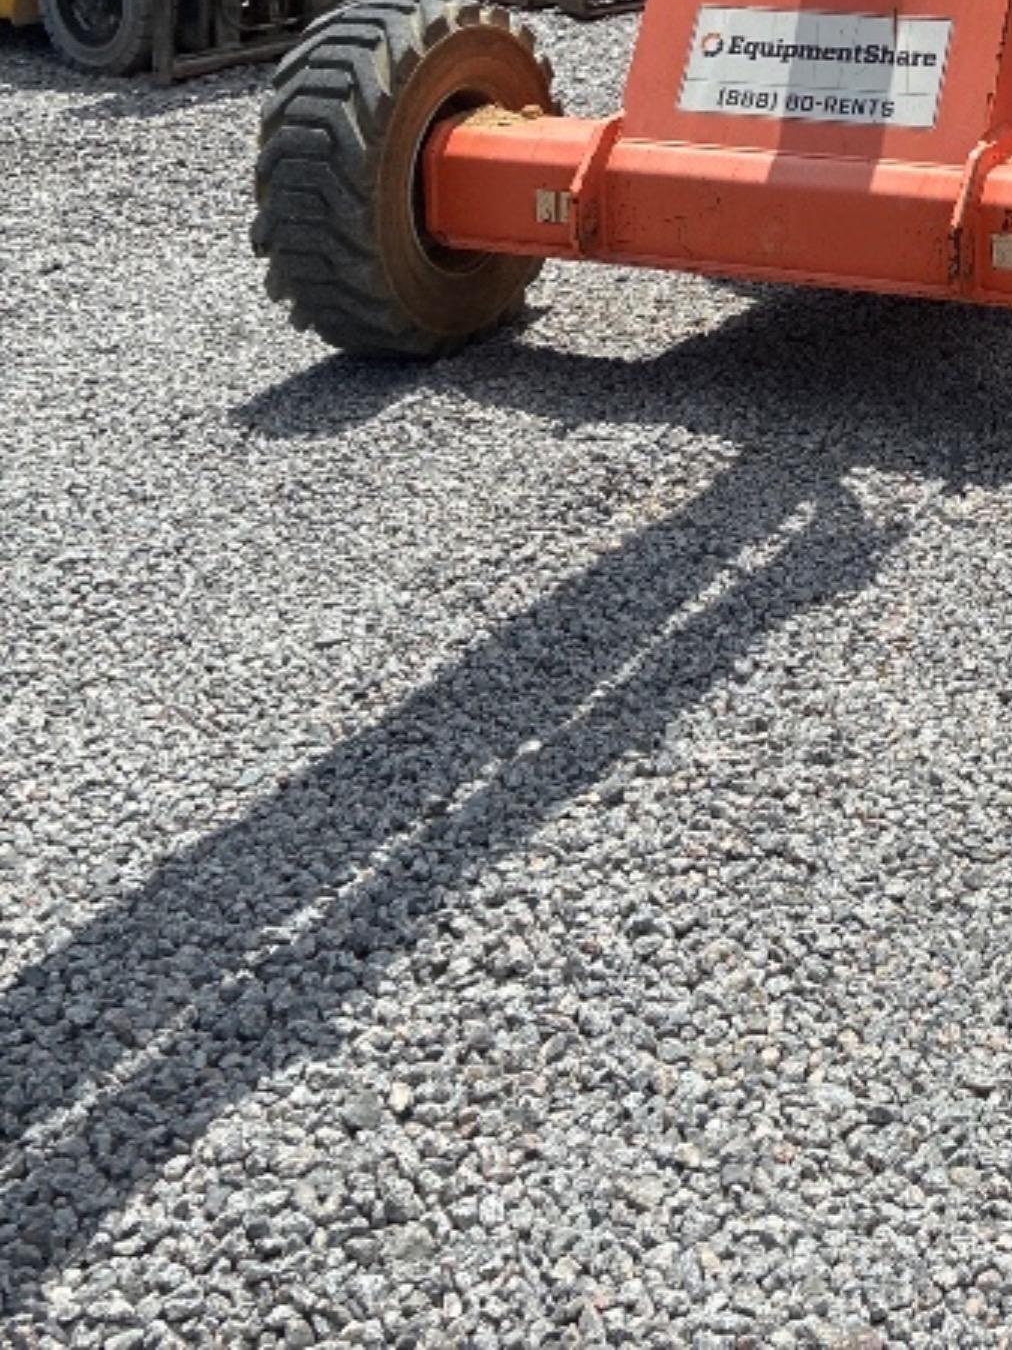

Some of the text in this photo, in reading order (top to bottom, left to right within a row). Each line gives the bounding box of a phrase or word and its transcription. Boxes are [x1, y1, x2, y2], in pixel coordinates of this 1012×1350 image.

[728, 35, 937, 67] EquipmentShare
[715, 87, 896, 119] (888) 80-RENTS
